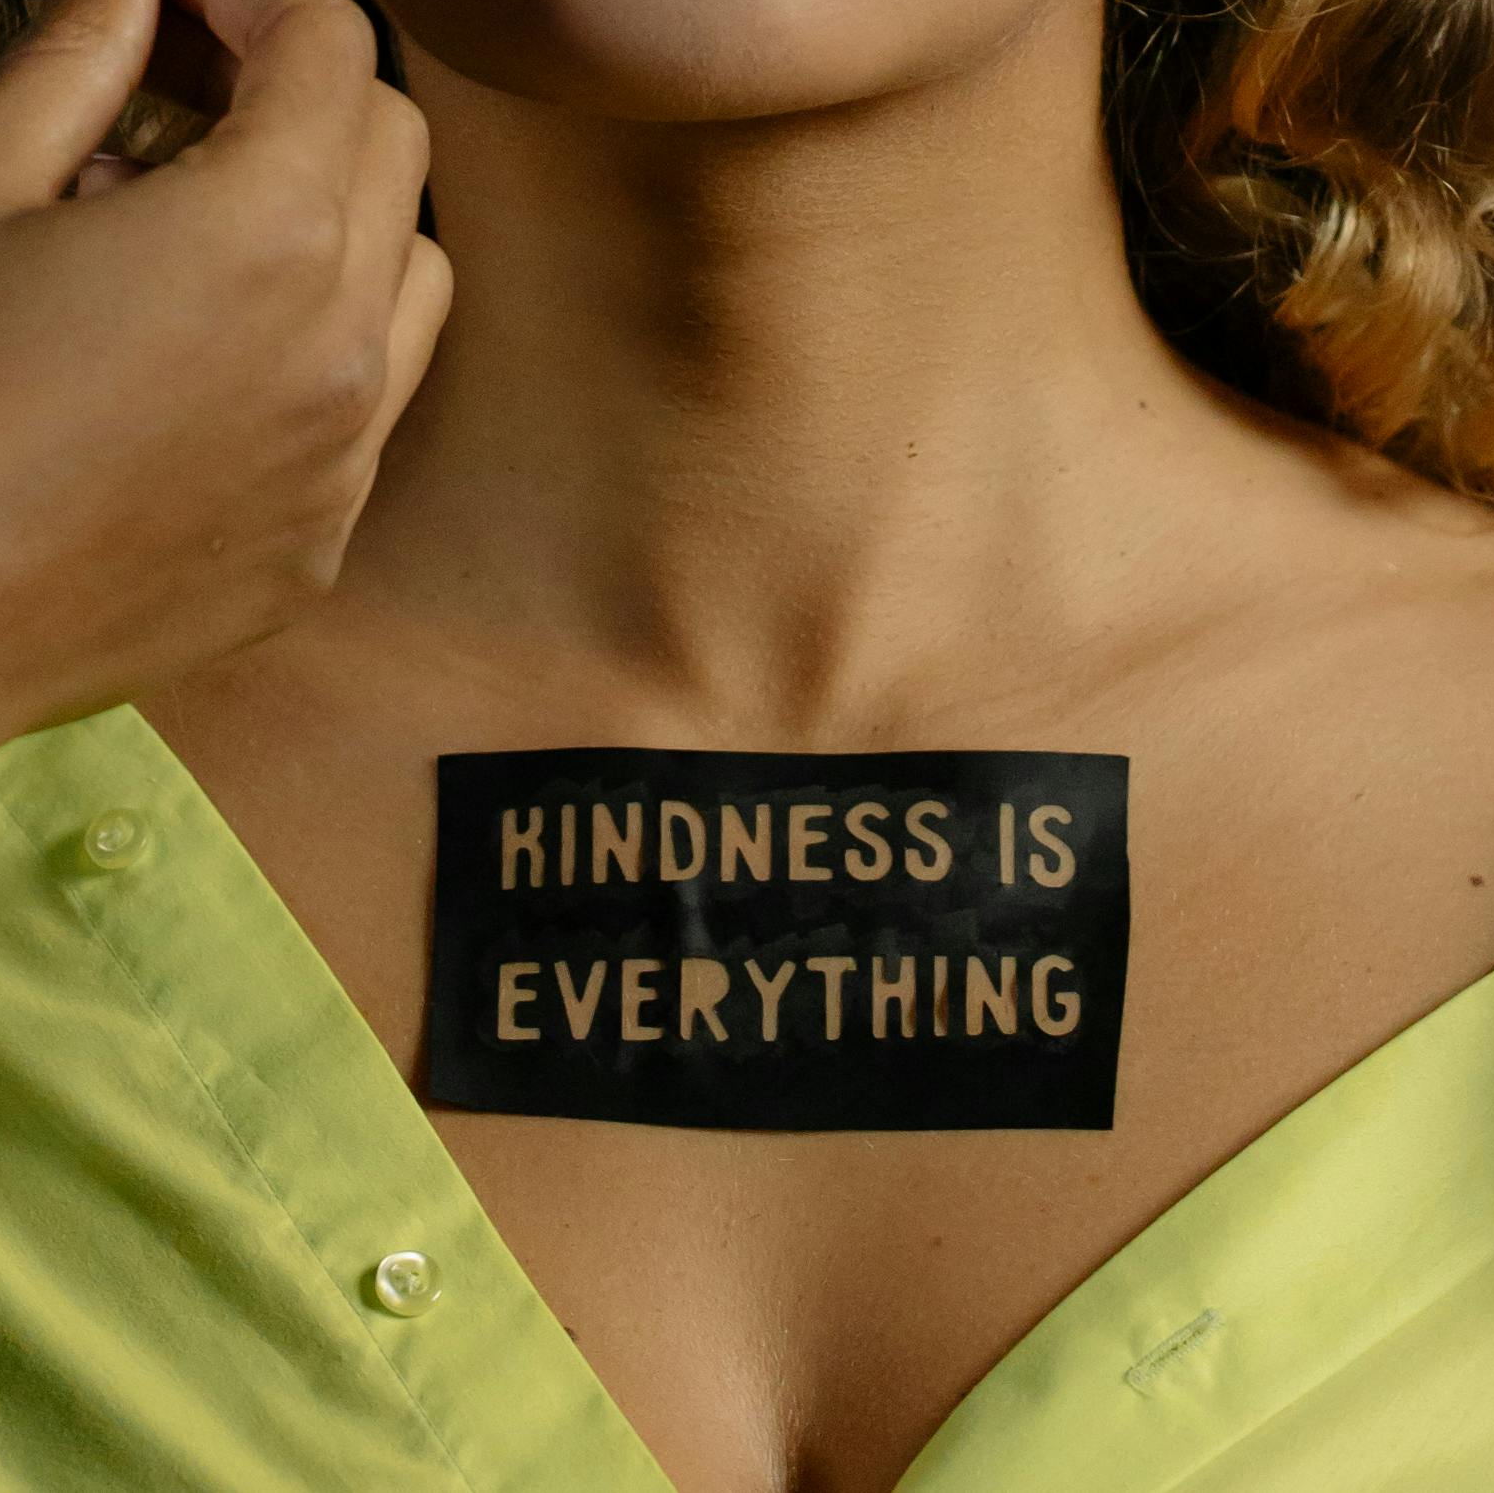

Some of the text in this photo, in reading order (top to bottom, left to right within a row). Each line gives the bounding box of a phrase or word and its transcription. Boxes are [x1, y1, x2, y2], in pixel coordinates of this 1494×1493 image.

[502, 800, 1076, 890] KINDNESS IS
[497, 954, 1081, 1042] EVERYTHING
